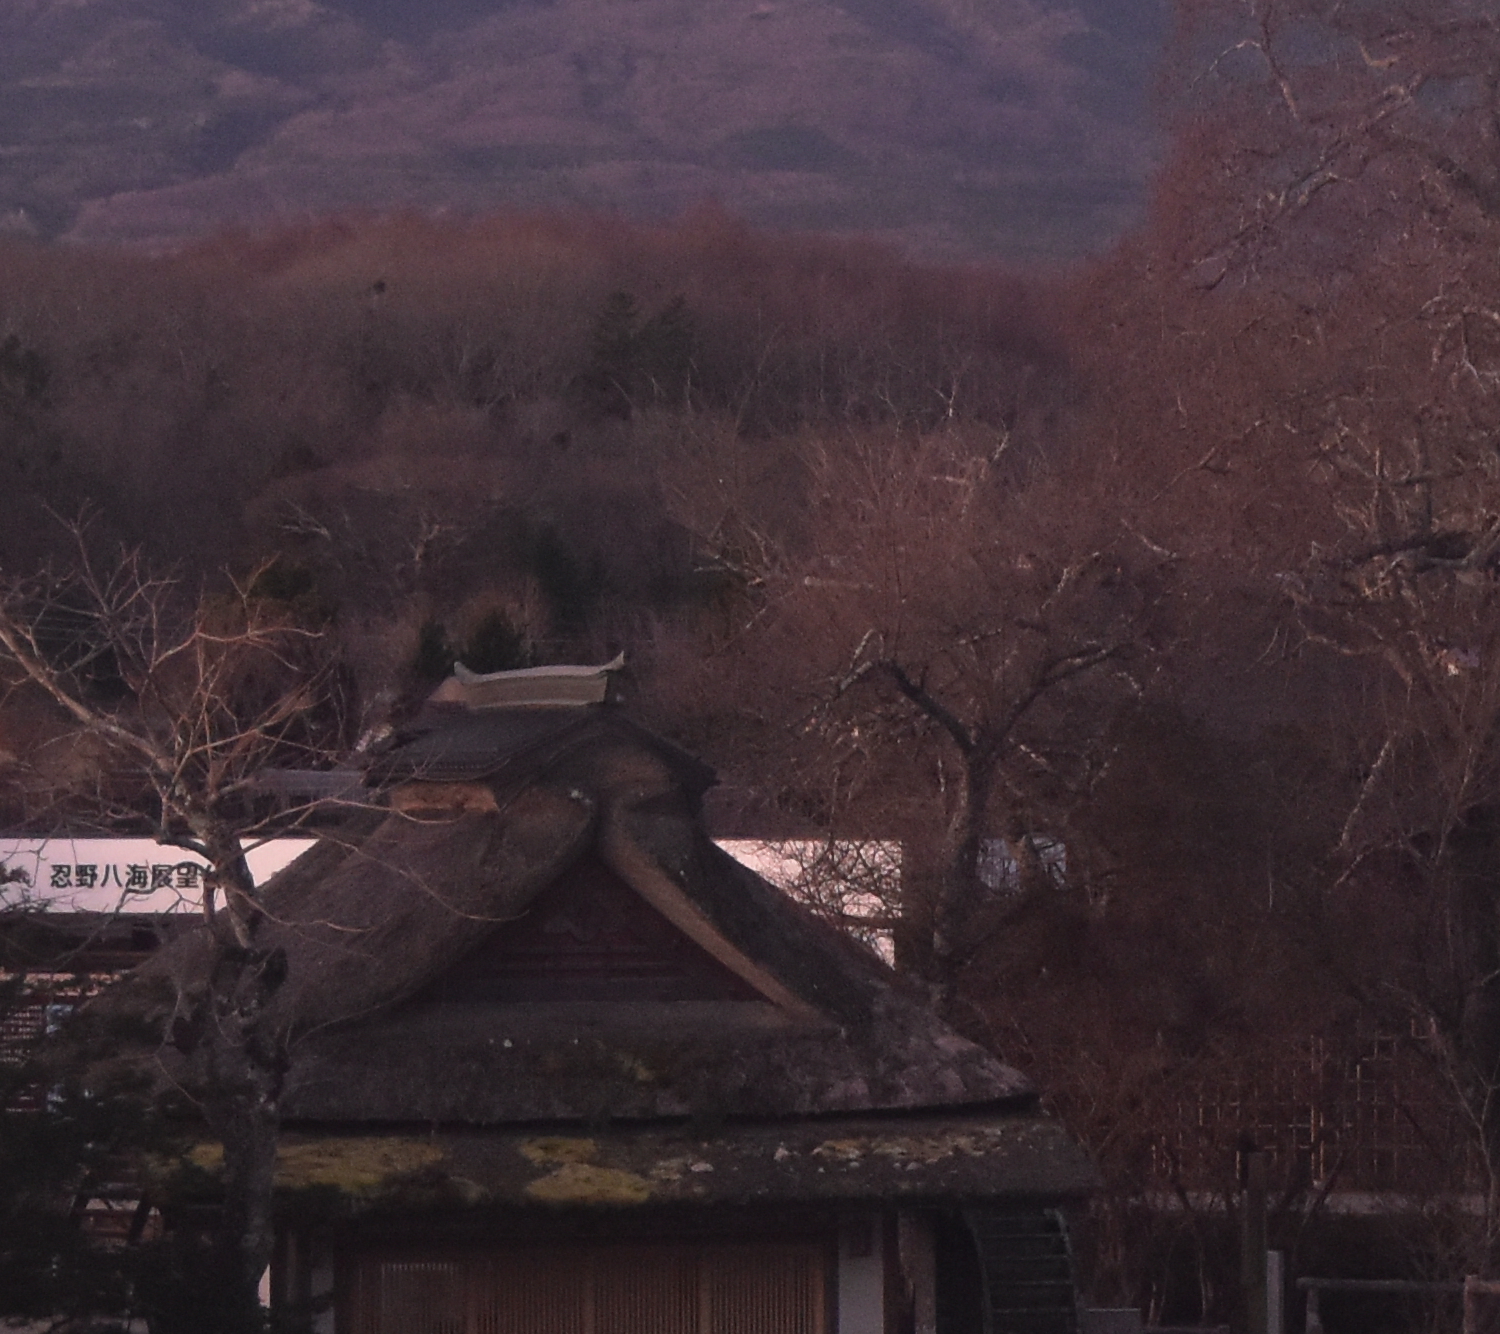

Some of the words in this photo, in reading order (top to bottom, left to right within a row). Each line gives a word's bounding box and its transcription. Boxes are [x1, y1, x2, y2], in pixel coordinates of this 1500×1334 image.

[50, 864, 220, 890] 忍野八海展望
